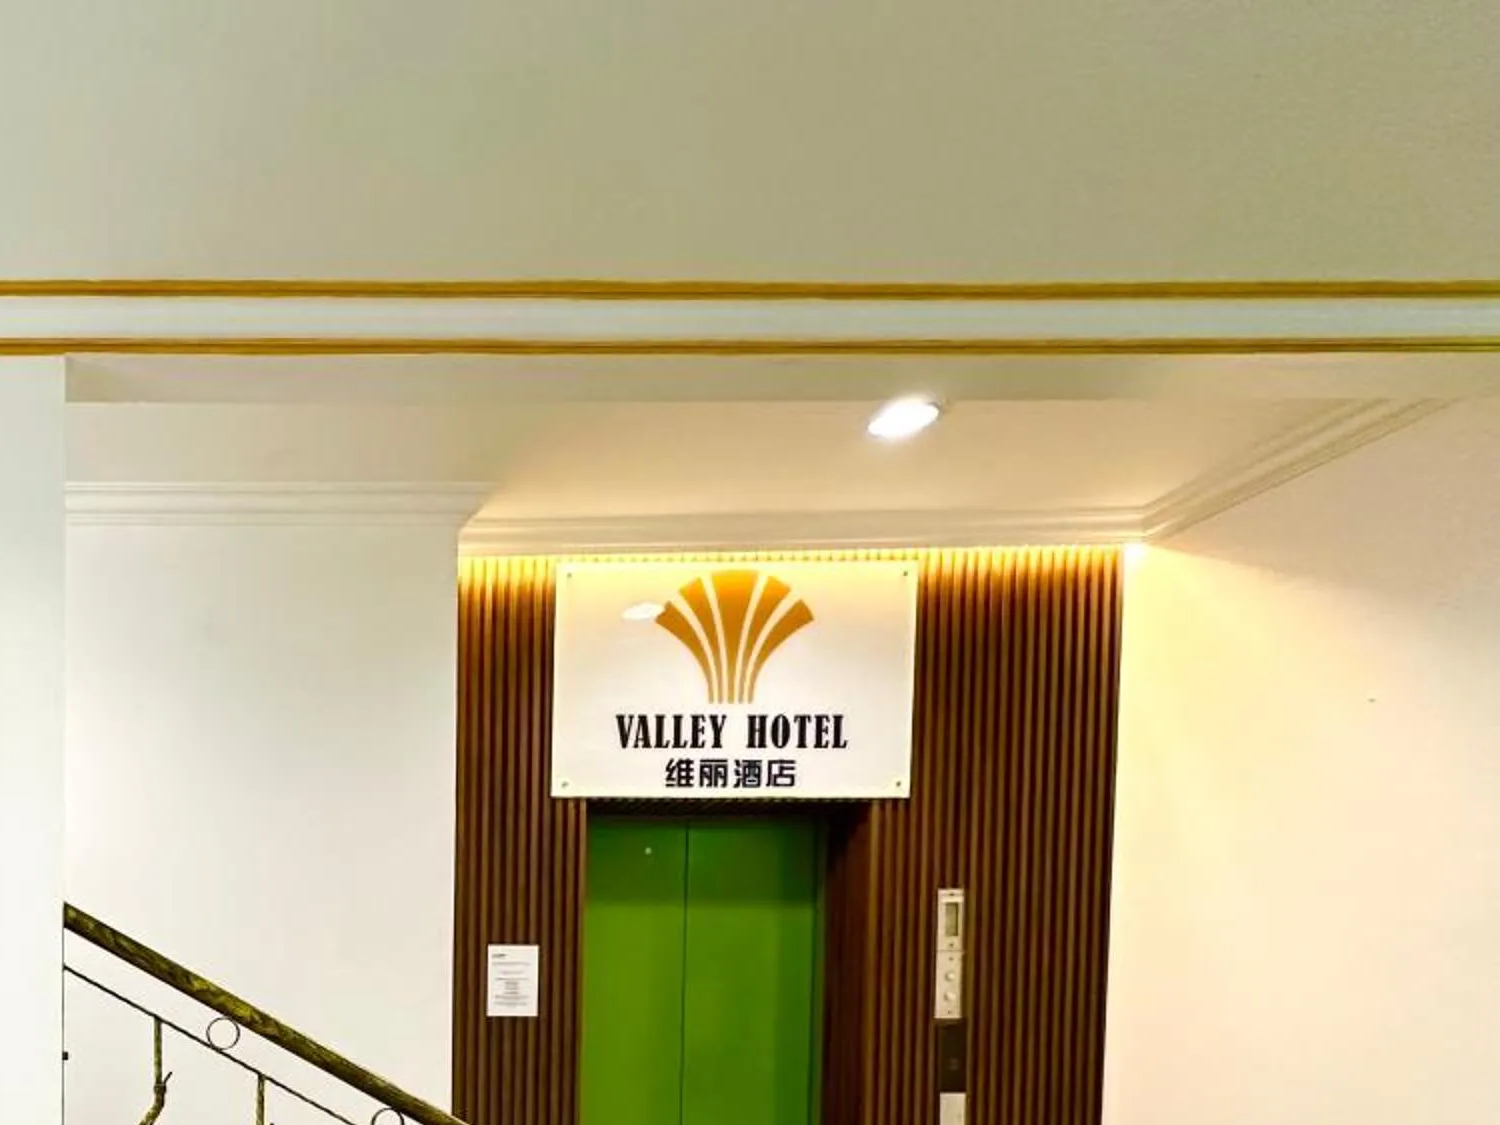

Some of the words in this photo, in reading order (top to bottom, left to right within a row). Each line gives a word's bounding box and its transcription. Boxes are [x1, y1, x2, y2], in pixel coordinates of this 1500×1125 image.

[615, 713, 727, 749] VALLEY
[746, 713, 849, 749] HOTEL
[665, 758, 796, 788] 维丽酒店
